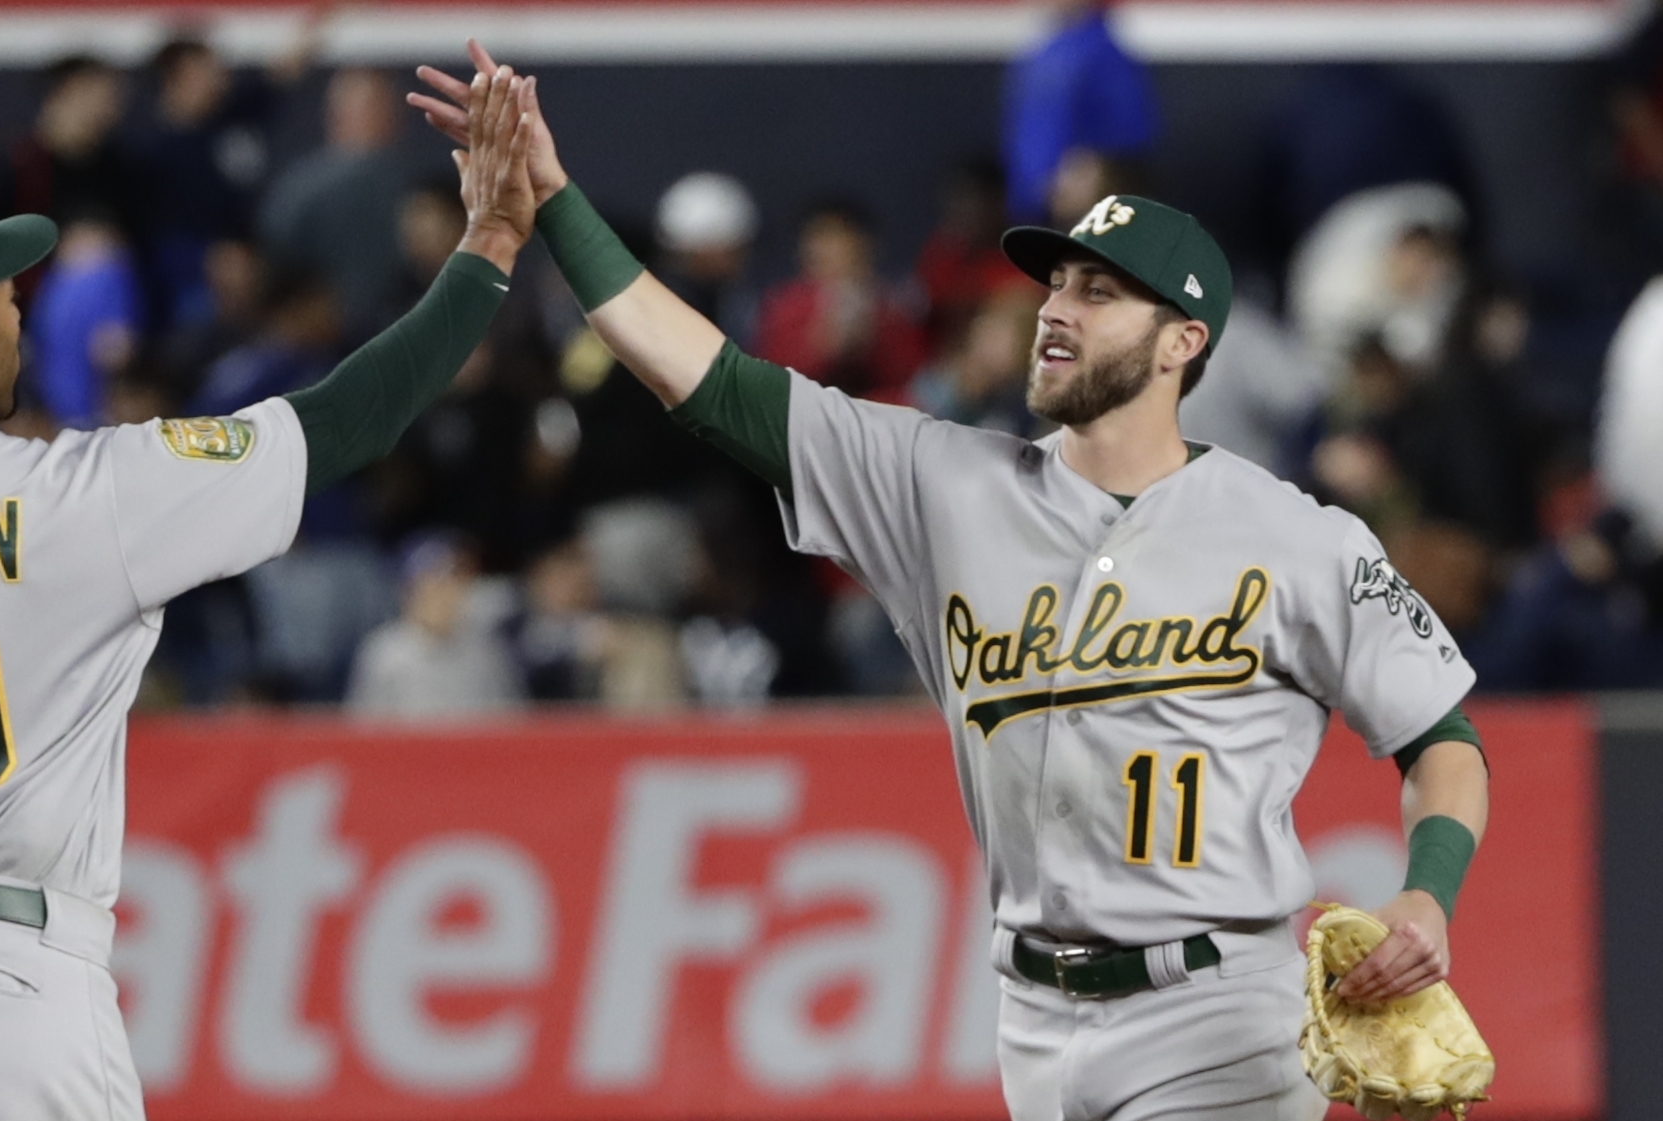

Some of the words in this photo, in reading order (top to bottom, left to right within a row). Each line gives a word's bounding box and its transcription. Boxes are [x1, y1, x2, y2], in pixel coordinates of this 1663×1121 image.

[1068, 194, 1136, 238] A's
[945, 567, 1269, 698] Oakland
[1121, 750, 1205, 869] 11
